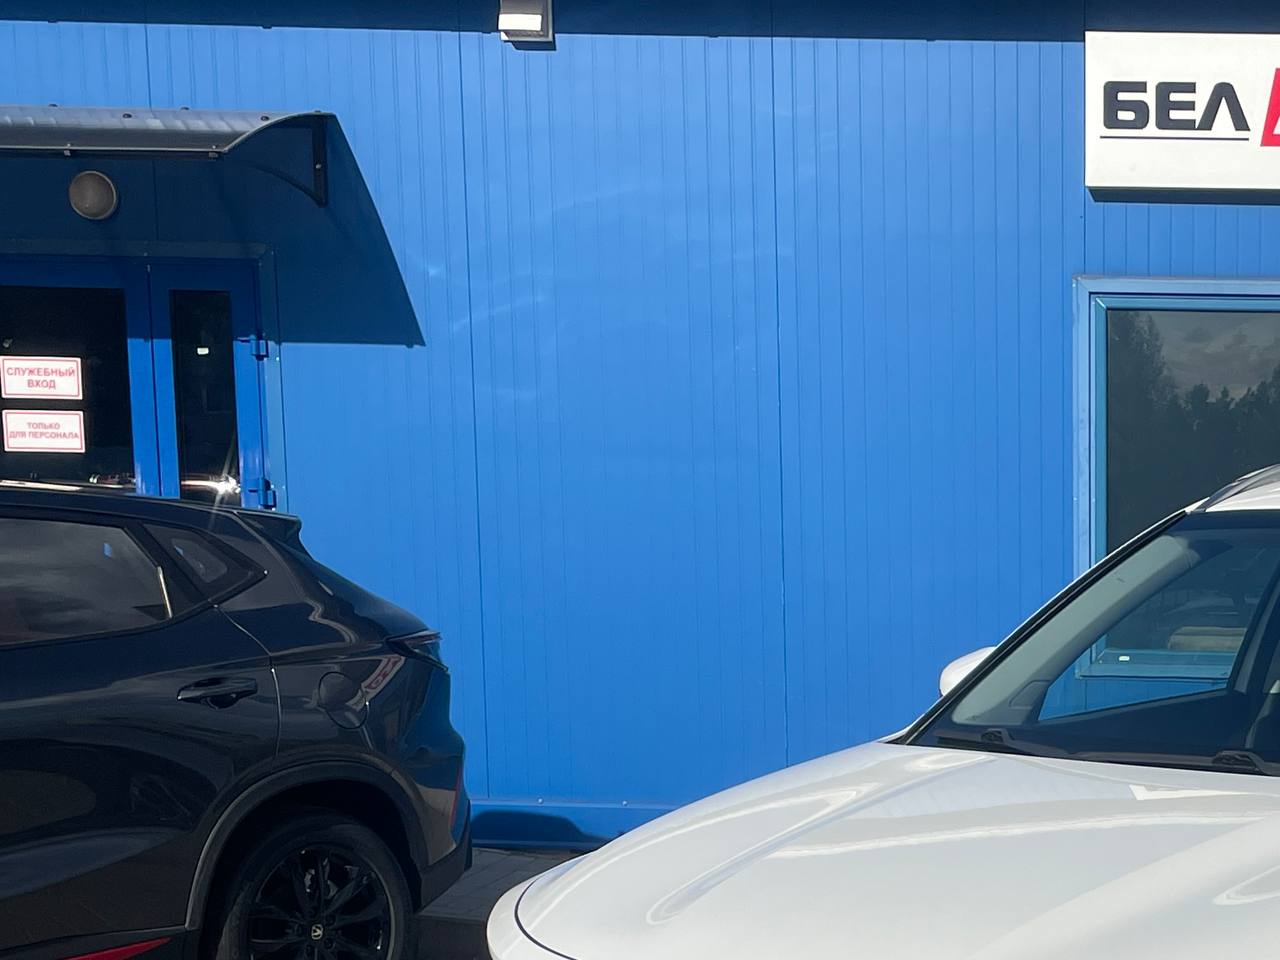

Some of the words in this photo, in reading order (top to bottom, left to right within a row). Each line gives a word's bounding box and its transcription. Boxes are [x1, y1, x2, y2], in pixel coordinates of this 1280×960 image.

[1101, 80, 1251, 133] БЕЛ
[6, 366, 76, 377] СЛУЖЕБНЫЙ
[27, 379, 56, 389] ВХОД
[27, 422, 61, 430] ТОЛЬКО
[9, 431, 27, 439] ДЛЯ
[28, 431, 79, 440] ПЕРСОНАЛА
